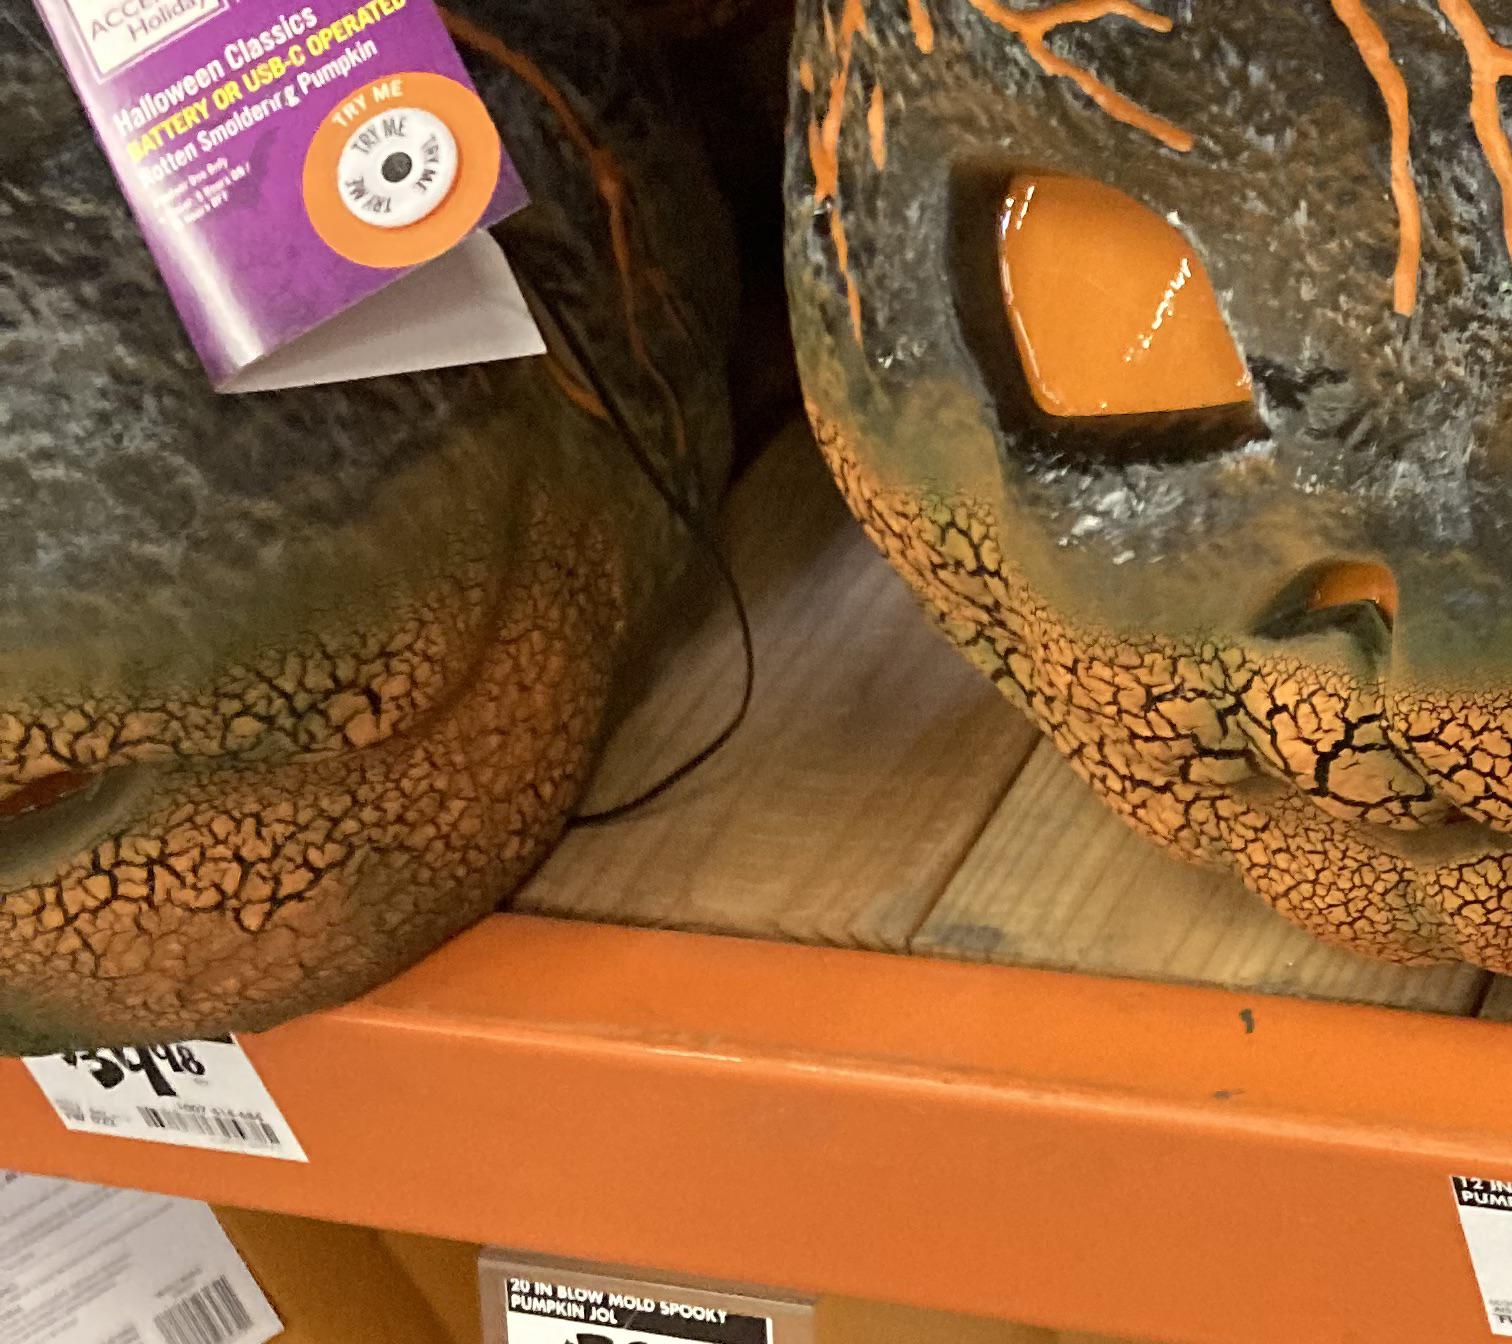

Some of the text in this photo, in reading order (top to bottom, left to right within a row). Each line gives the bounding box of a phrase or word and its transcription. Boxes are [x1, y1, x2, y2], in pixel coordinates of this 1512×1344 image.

[112, 7, 318, 136] Halloween Classics
[212, 80, 243, 110] OR
[242, 44, 306, 93] USB-C
[197, 84, 301, 153] Smoldering
[297, 39, 378, 95] Pumpkin
[332, 79, 403, 128] TRY ME
[351, 116, 407, 154] TRY ME
[1460, 1175, 1484, 1190] 12
[1491, 1179, 1512, 1195] IN
[510, 1277, 728, 1325] 20 IN BLOW MOLD SPOOKY
[511, 1294, 618, 1325] PUMPKIN JOL
